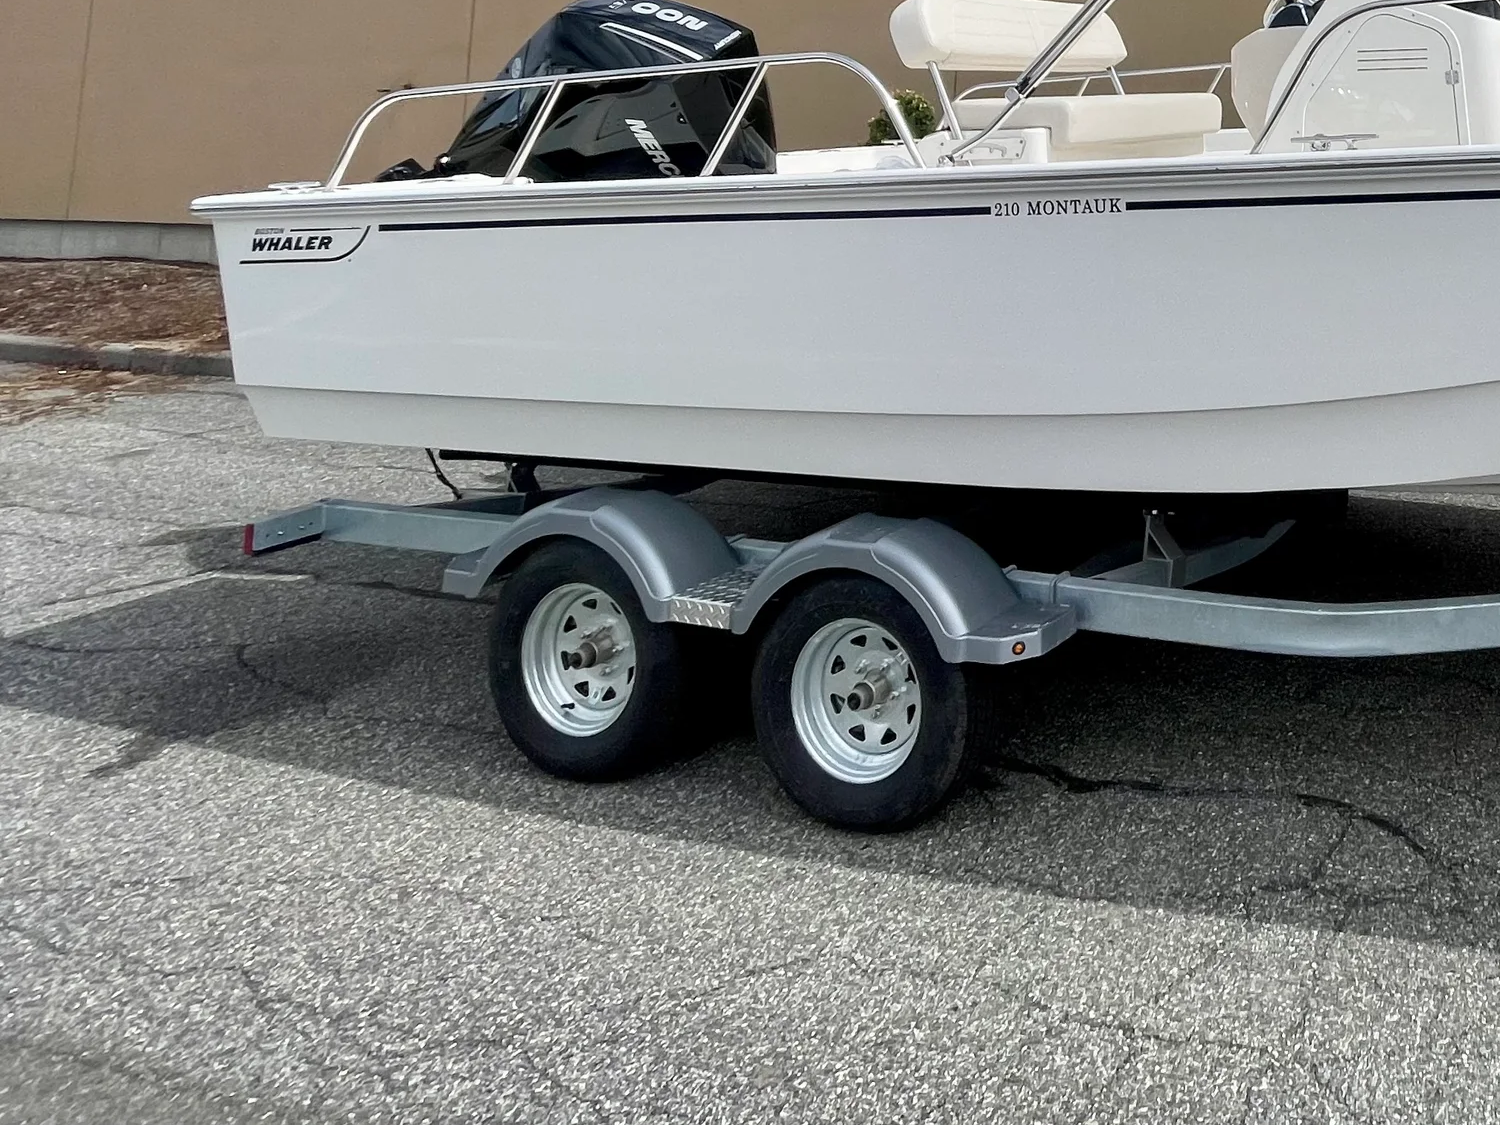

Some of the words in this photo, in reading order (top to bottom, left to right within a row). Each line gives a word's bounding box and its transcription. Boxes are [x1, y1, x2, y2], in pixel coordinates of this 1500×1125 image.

[631, 2, 708, 31] 200
[624, 118, 682, 177] MERC
[994, 202, 1019, 217] 210
[1027, 198, 1122, 216] MONTAUK
[254, 228, 284, 236] BOSTON
[251, 235, 333, 252] WHALER
